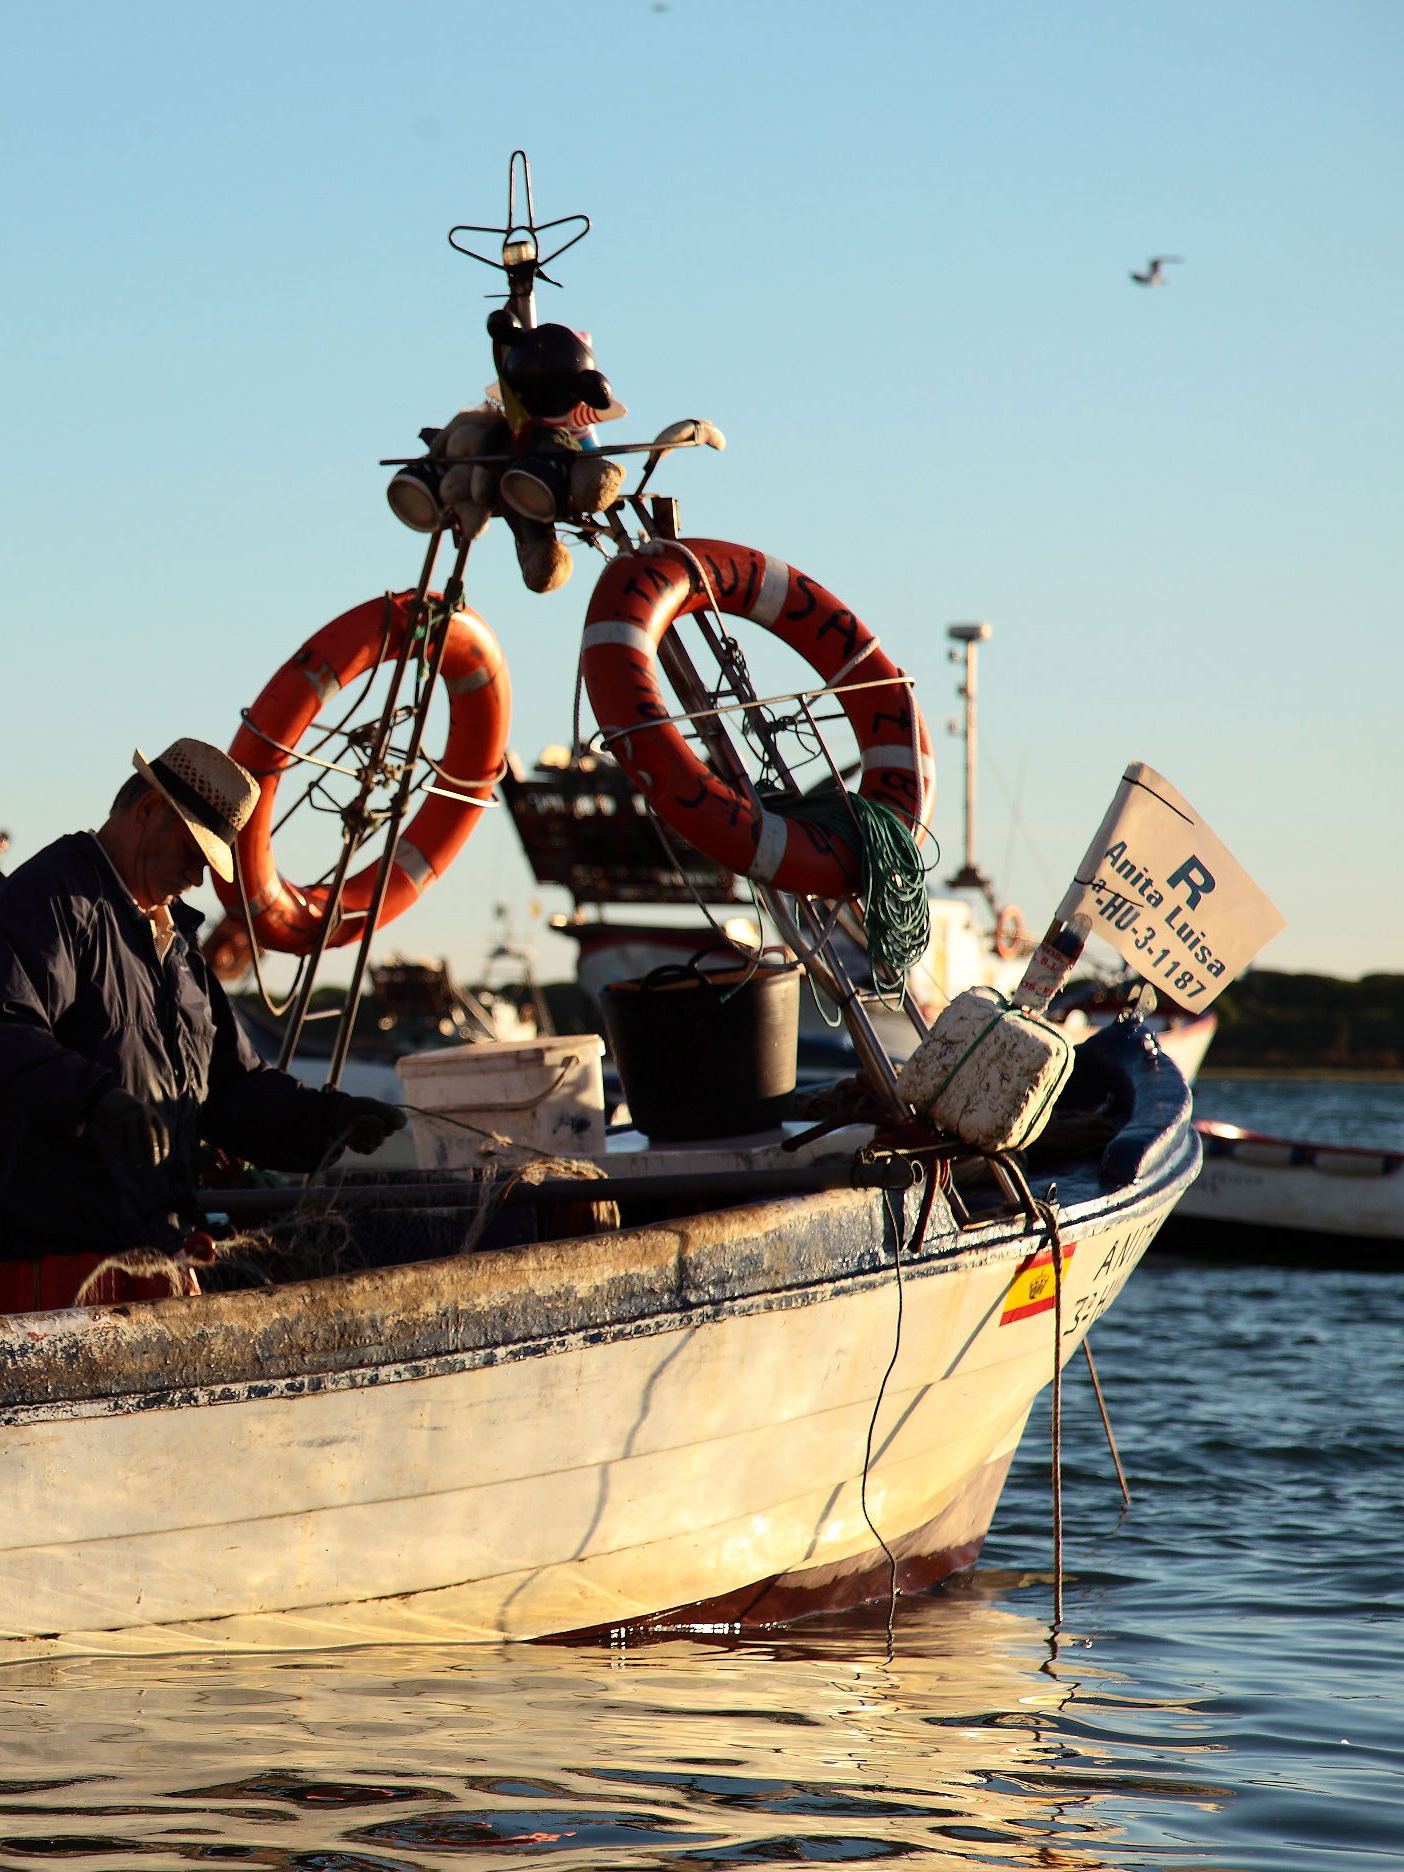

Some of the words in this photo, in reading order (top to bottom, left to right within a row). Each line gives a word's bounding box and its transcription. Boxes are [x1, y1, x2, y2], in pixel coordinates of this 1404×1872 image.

[1103, 840, 1165, 909] Anita
[1163, 904, 1227, 978] Luisa
[1165, 853, 1217, 913] R
